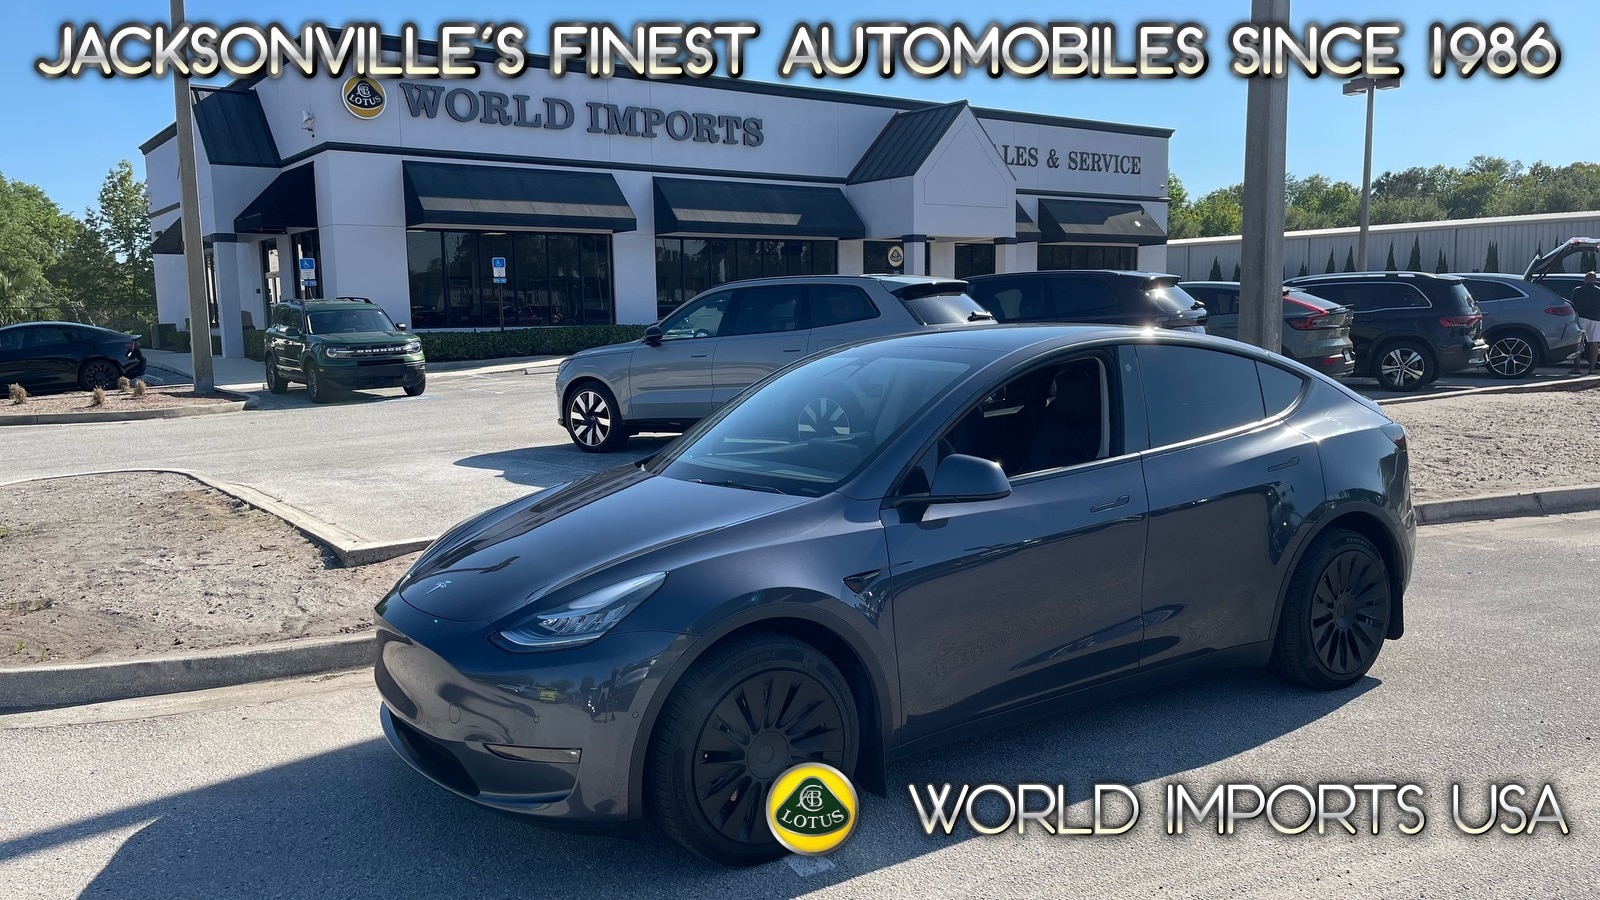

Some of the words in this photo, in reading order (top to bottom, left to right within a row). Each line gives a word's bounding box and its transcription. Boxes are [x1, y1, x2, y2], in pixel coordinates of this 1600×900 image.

[349, 94, 381, 105] LOTUS
[399, 82, 575, 130] WORLD
[586, 101, 765, 147] IMPORTS
[1001, 144, 1039, 168] LES
[1046, 148, 1060, 169] &
[1068, 151, 1142, 175] SERVICE
